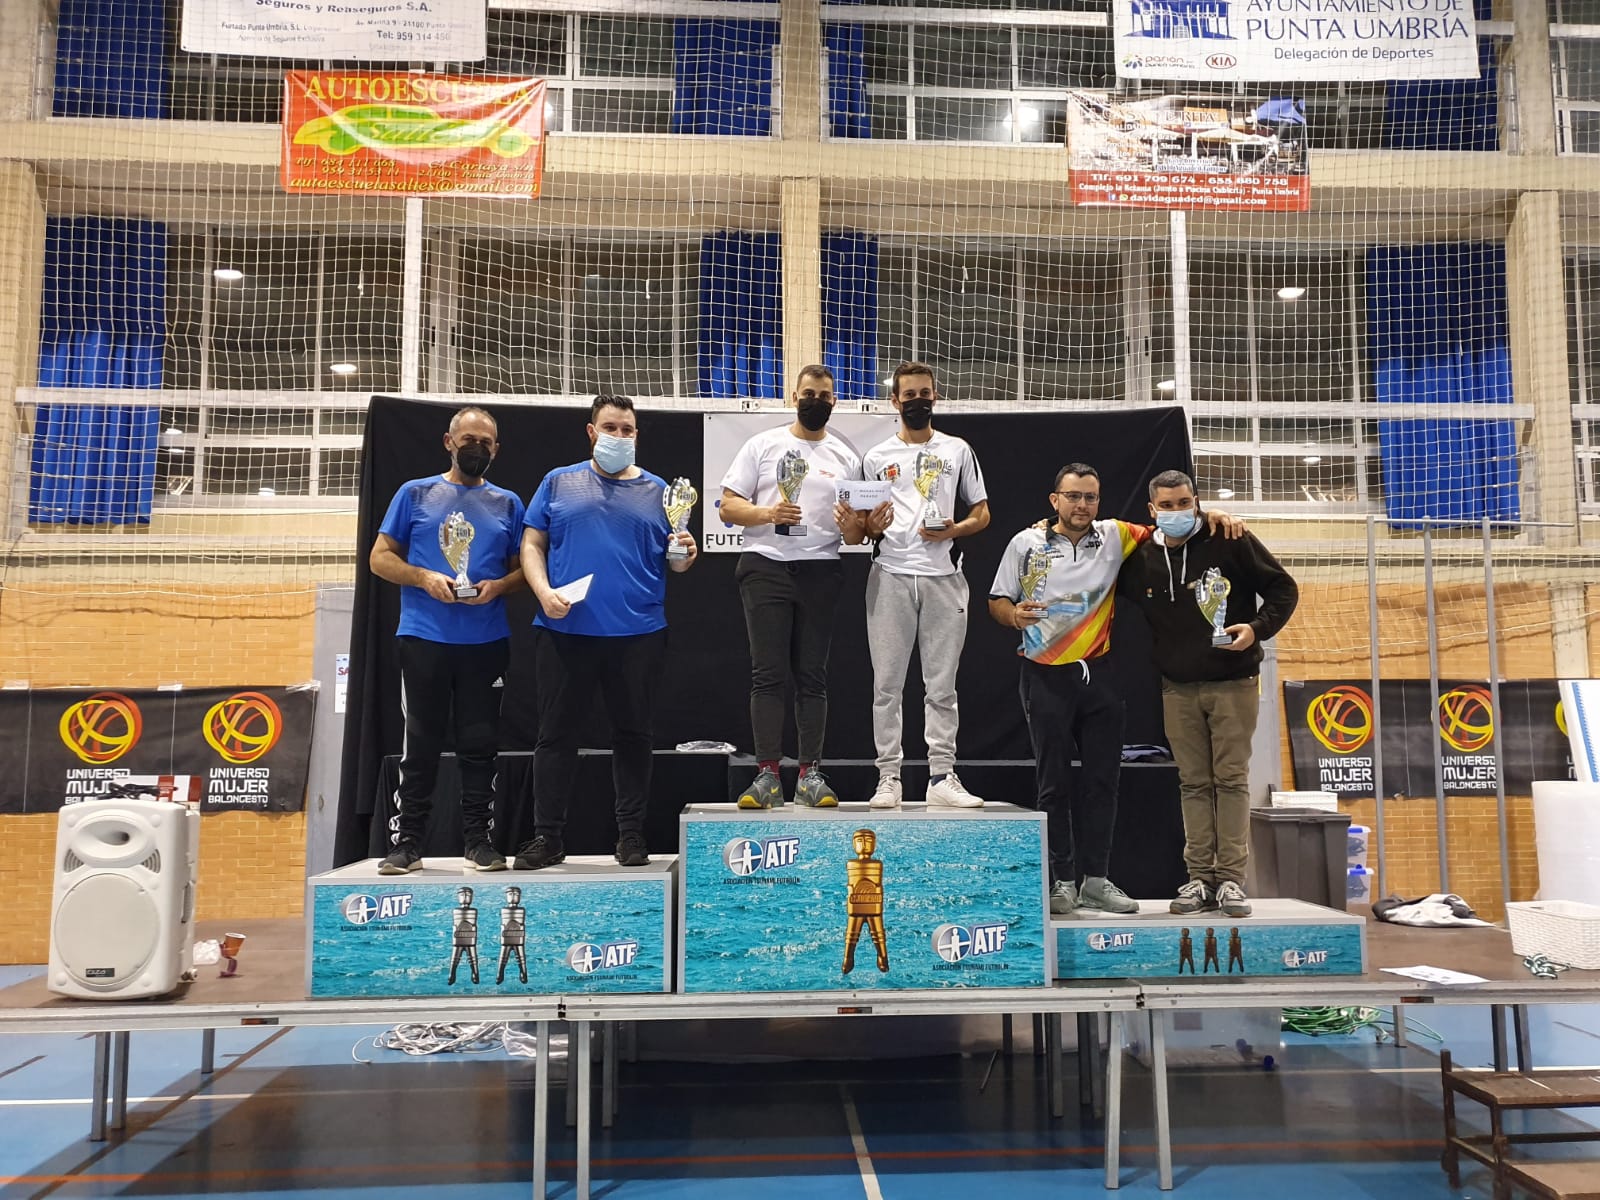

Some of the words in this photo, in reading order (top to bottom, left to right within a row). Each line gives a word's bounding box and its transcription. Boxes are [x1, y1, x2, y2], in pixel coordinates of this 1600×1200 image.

[256, 0, 311, 10] Seguros
[316, 5, 323, 13] y
[406, 1, 432, 12] S.A.
[1247, 0, 1428, 12] AYUNTAMIENTO
[1435, 0, 1464, 11] DE
[1246, 18, 1346, 40] PUNTA
[1354, 12, 1469, 40] UMBRÍA
[377, 30, 394, 40] Tel:
[396, 31, 413, 41] 959
[1274, 47, 1348, 62] Delegación
[1352, 47, 1368, 59] de
[1372, 46, 1434, 61] Deportes
[1211, 57, 1232, 66] KIA
[303, 75, 533, 105] AUTOESCUELA
[1116, 174, 1139, 182] 691
[1144, 175, 1168, 183] 709
[1171, 176, 1196, 184] 674
[1252, 187, 1273, 195] Punta
[1318, 757, 1373, 768] UNIVERSO
[1441, 755, 1496, 766] UNIVERSO
[66, 768, 131, 779] UNIVERSO
[210, 767, 270, 779] UNIVERSO
[1320, 768, 1373, 783] MUJER
[1443, 766, 1497, 780] MUJER
[65, 780, 112, 794] MUJ
[208, 779, 269, 794] MUJER
[1320, 782, 1374, 792] BALONCESTO
[1443, 781, 1497, 790] BALONCESTO
[208, 794, 269, 804] BALONCESTO
[765, 839, 799, 869] ATF
[380, 894, 412, 919] ATF
[973, 925, 1006, 955] ATF
[1113, 933, 1135, 947] ATF
[605, 943, 637, 968] ATF
[1307, 950, 1329, 964] ATF
